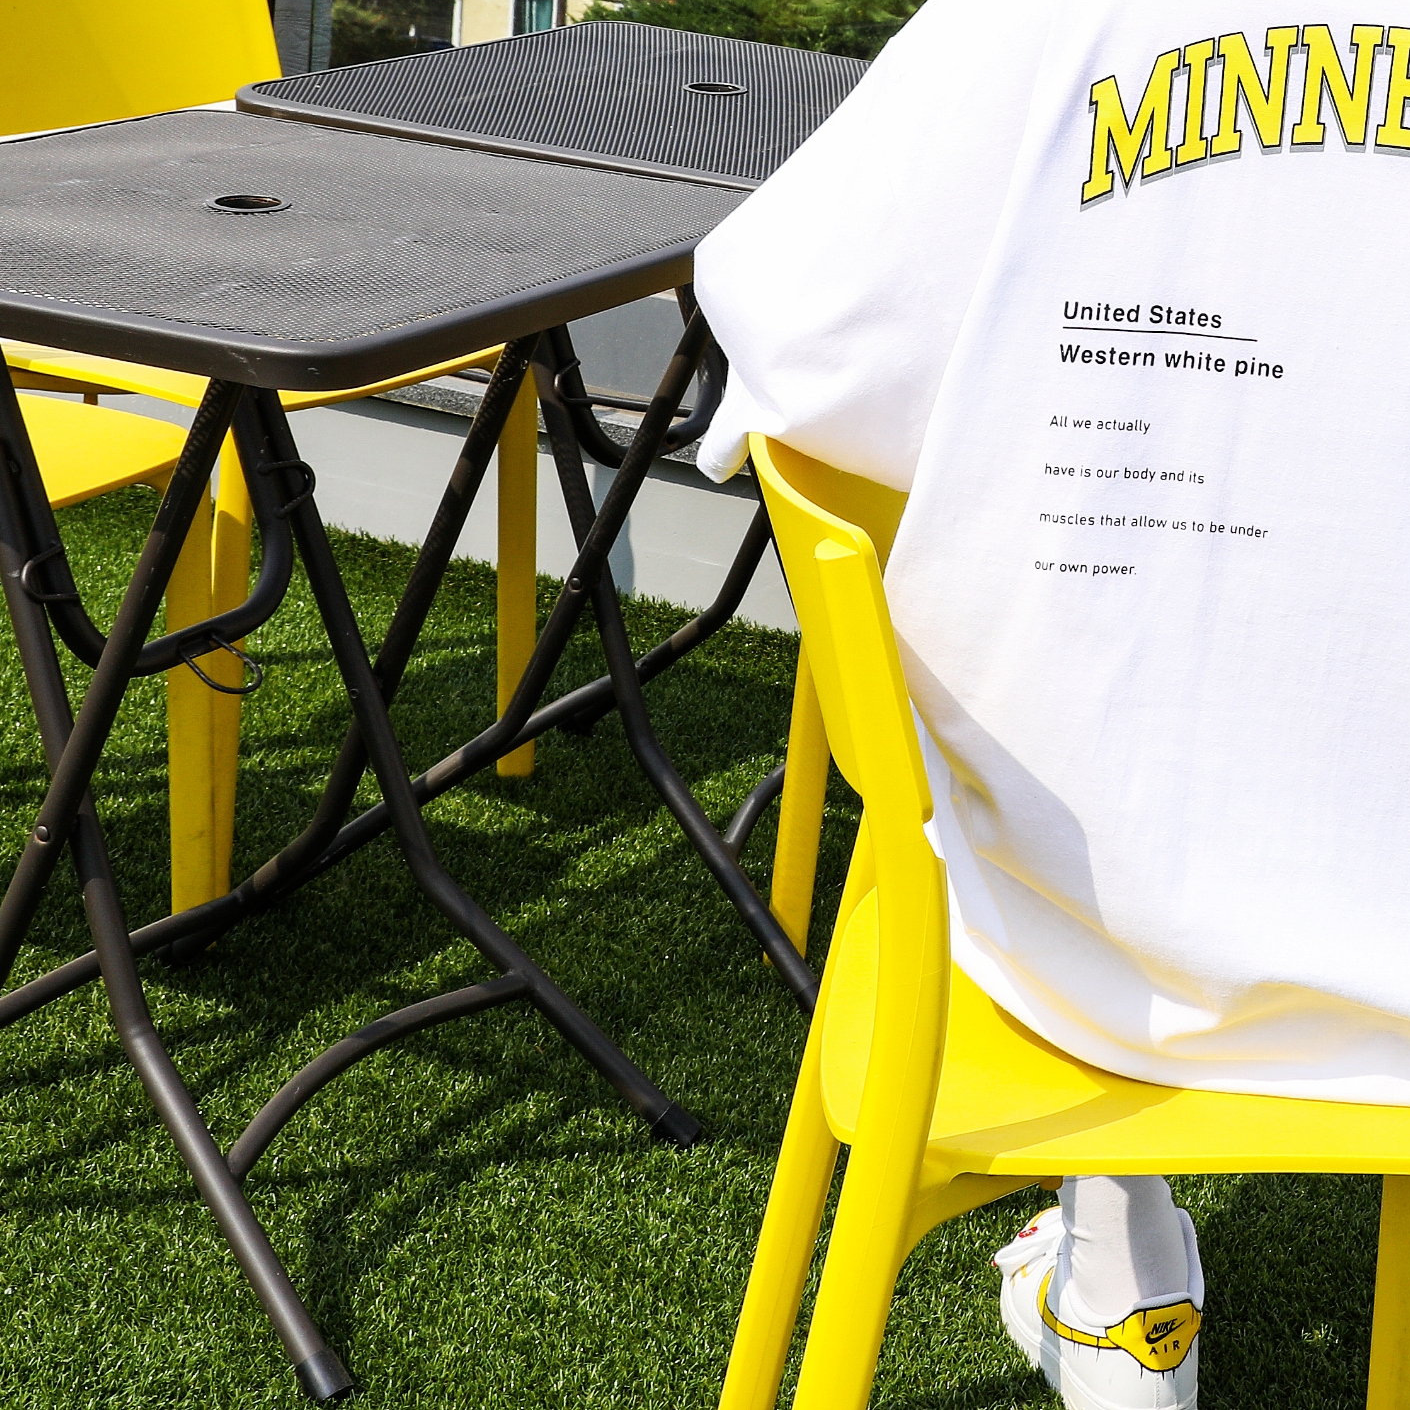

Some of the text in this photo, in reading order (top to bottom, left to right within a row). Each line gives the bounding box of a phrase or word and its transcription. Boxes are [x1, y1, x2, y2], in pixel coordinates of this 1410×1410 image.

[1063, 300, 1222, 329] United States
[1059, 343, 1284, 379] Western white pine
[1049, 415, 1151, 435] All we actually
[1044, 462, 1205, 485] have is our body and its
[1039, 513, 1269, 539] muscles that allow us to be under
[1034, 560, 1137, 577] our own power.
[1151, 1318, 1178, 1335] NIKE
[1149, 1340, 1181, 1356] AIR
